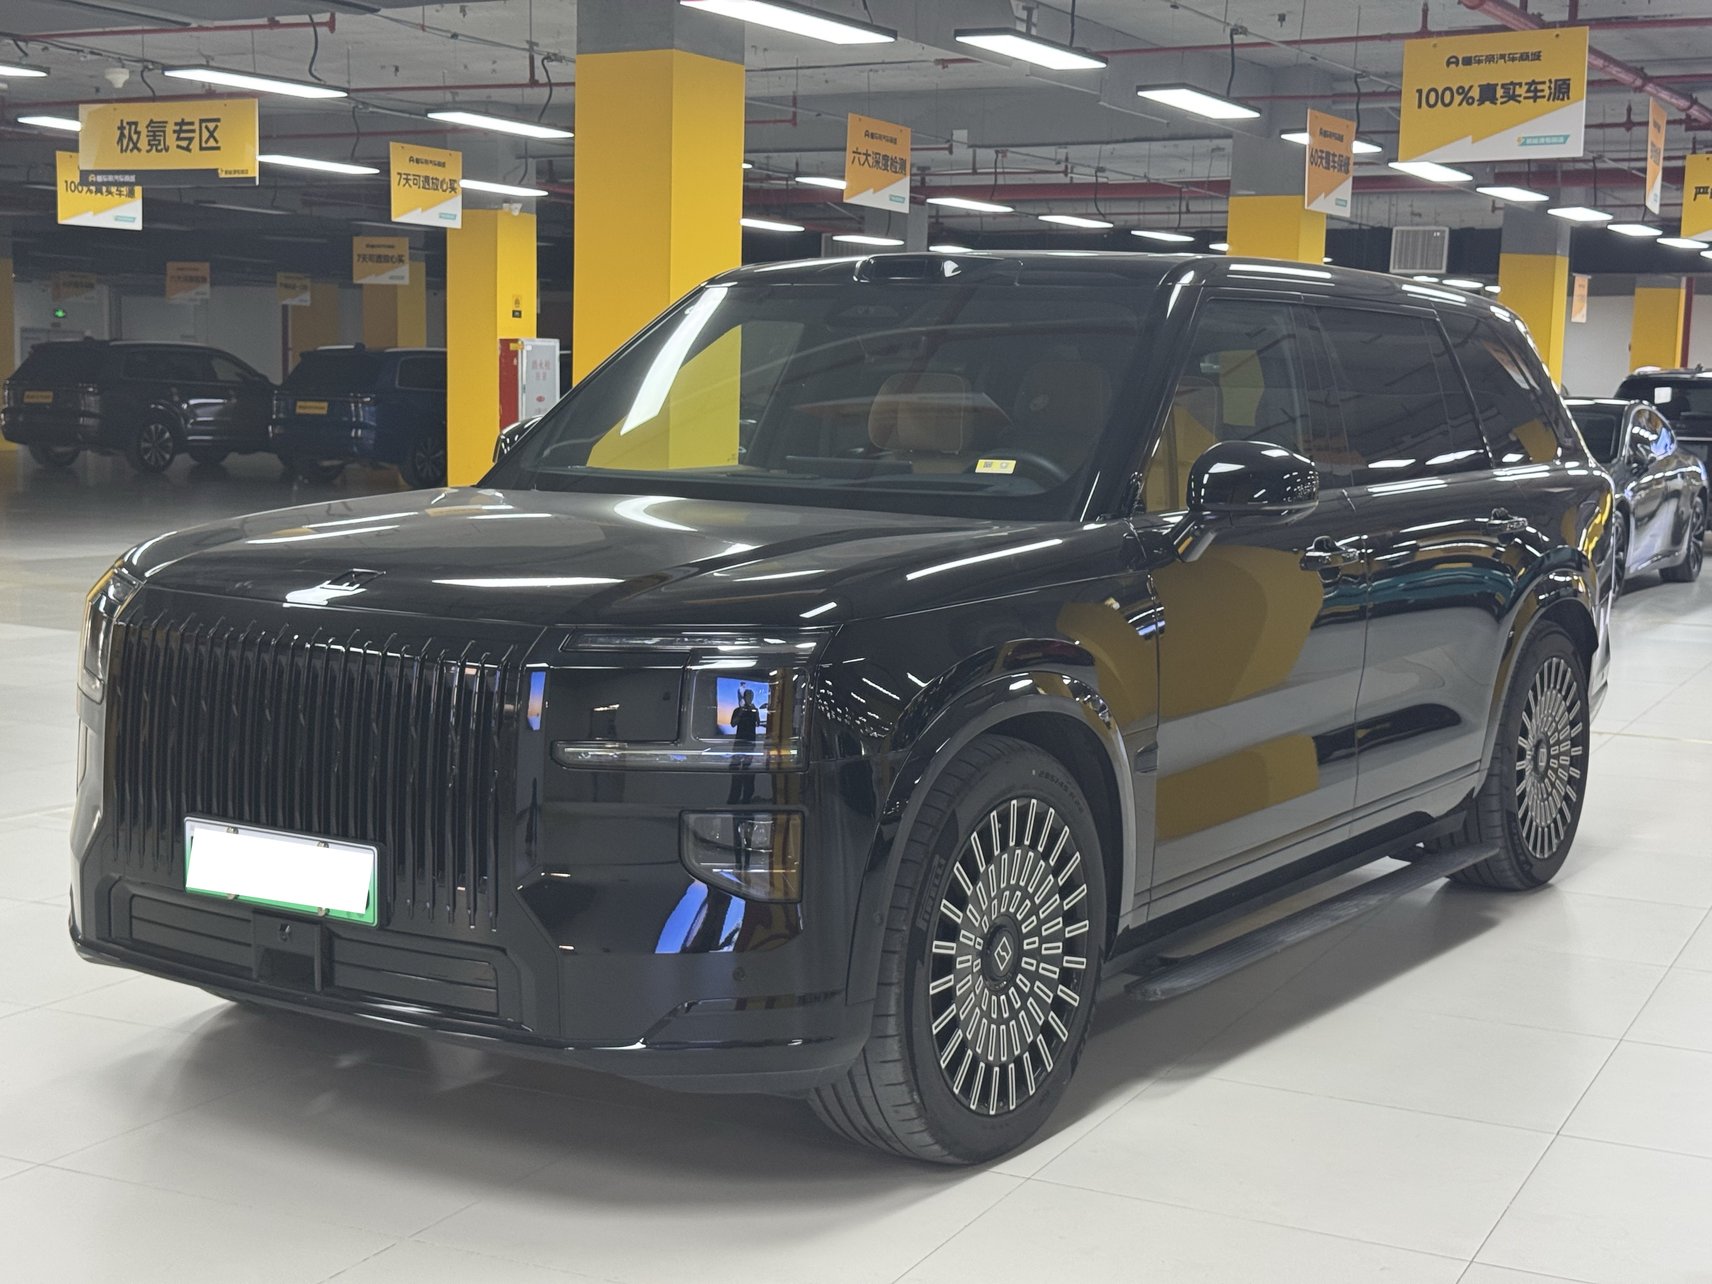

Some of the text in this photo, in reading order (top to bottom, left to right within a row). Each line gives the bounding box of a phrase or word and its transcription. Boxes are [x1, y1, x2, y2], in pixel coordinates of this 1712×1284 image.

[1415, 78, 1572, 109] 100%真实车源
[116, 117, 222, 154] 极氪专区
[851, 147, 907, 176] 六大深度检测
[396, 172, 458, 194] 7天可退放心买
[1693, 185, 1712, 202] 严
